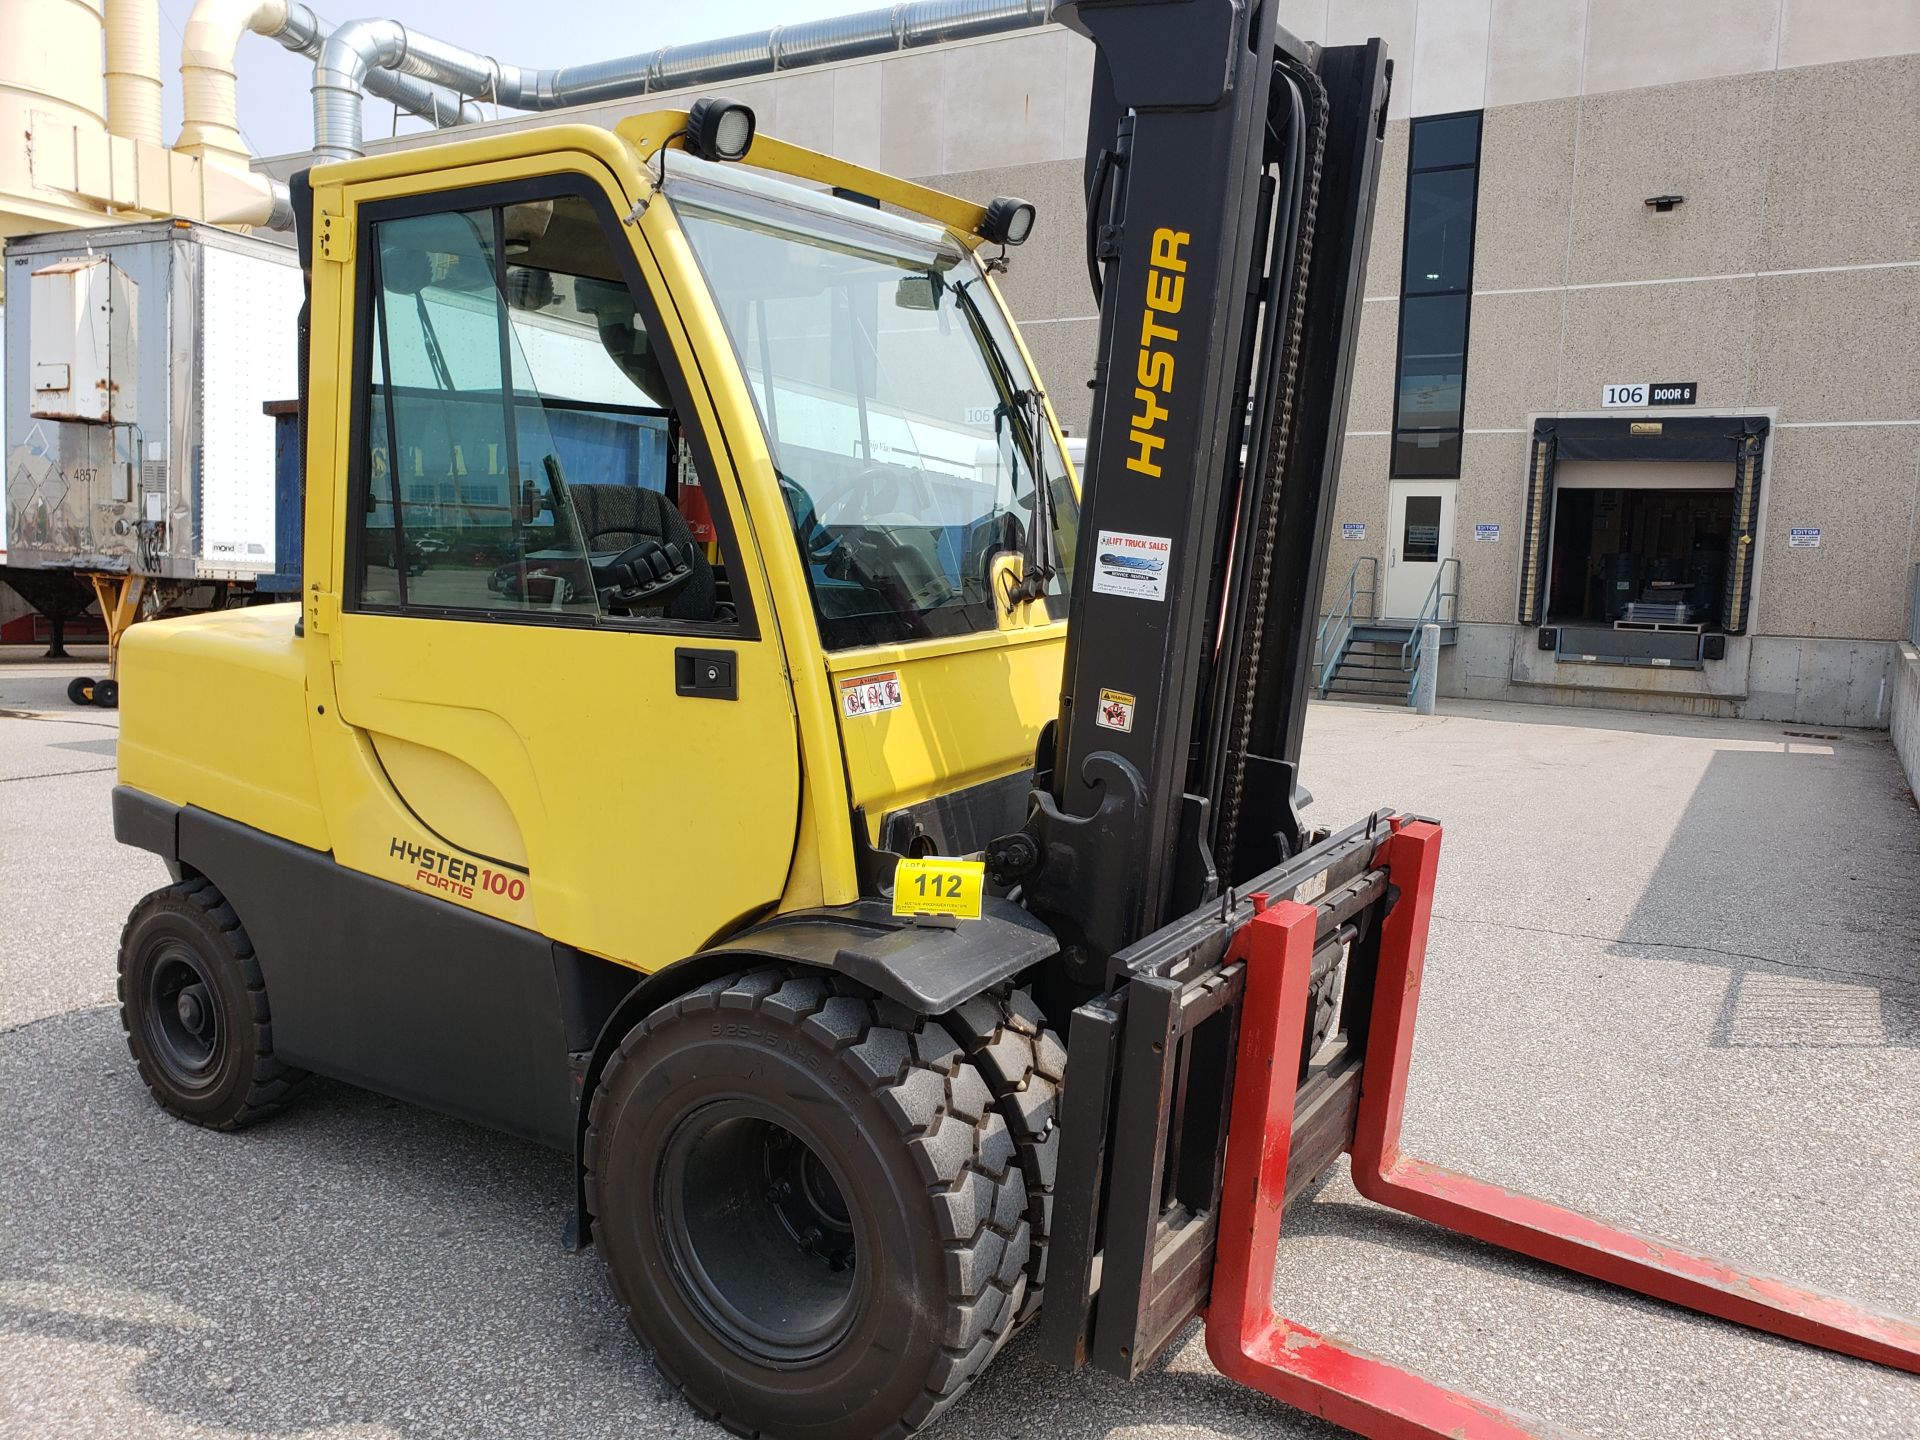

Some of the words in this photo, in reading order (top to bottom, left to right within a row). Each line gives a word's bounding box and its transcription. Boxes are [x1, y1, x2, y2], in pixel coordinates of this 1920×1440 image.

[1126, 227, 1190, 478] HYSTER
[1608, 387, 1643, 404] 106
[1654, 388, 1682, 400] DOOR
[1684, 388, 1690, 399] 6
[967, 409, 990, 422] 106
[73, 468, 98, 482] 4857
[1109, 536, 1123, 545] LIFT
[1125, 538, 1147, 549] TRUCK
[1148, 541, 1169, 551] SALES
[1110, 694, 1132, 703] WARNING
[389, 837, 478, 886] HYSTER
[416, 869, 474, 899] FORTIS
[482, 869, 525, 901] 100
[914, 873, 962, 897] 112
